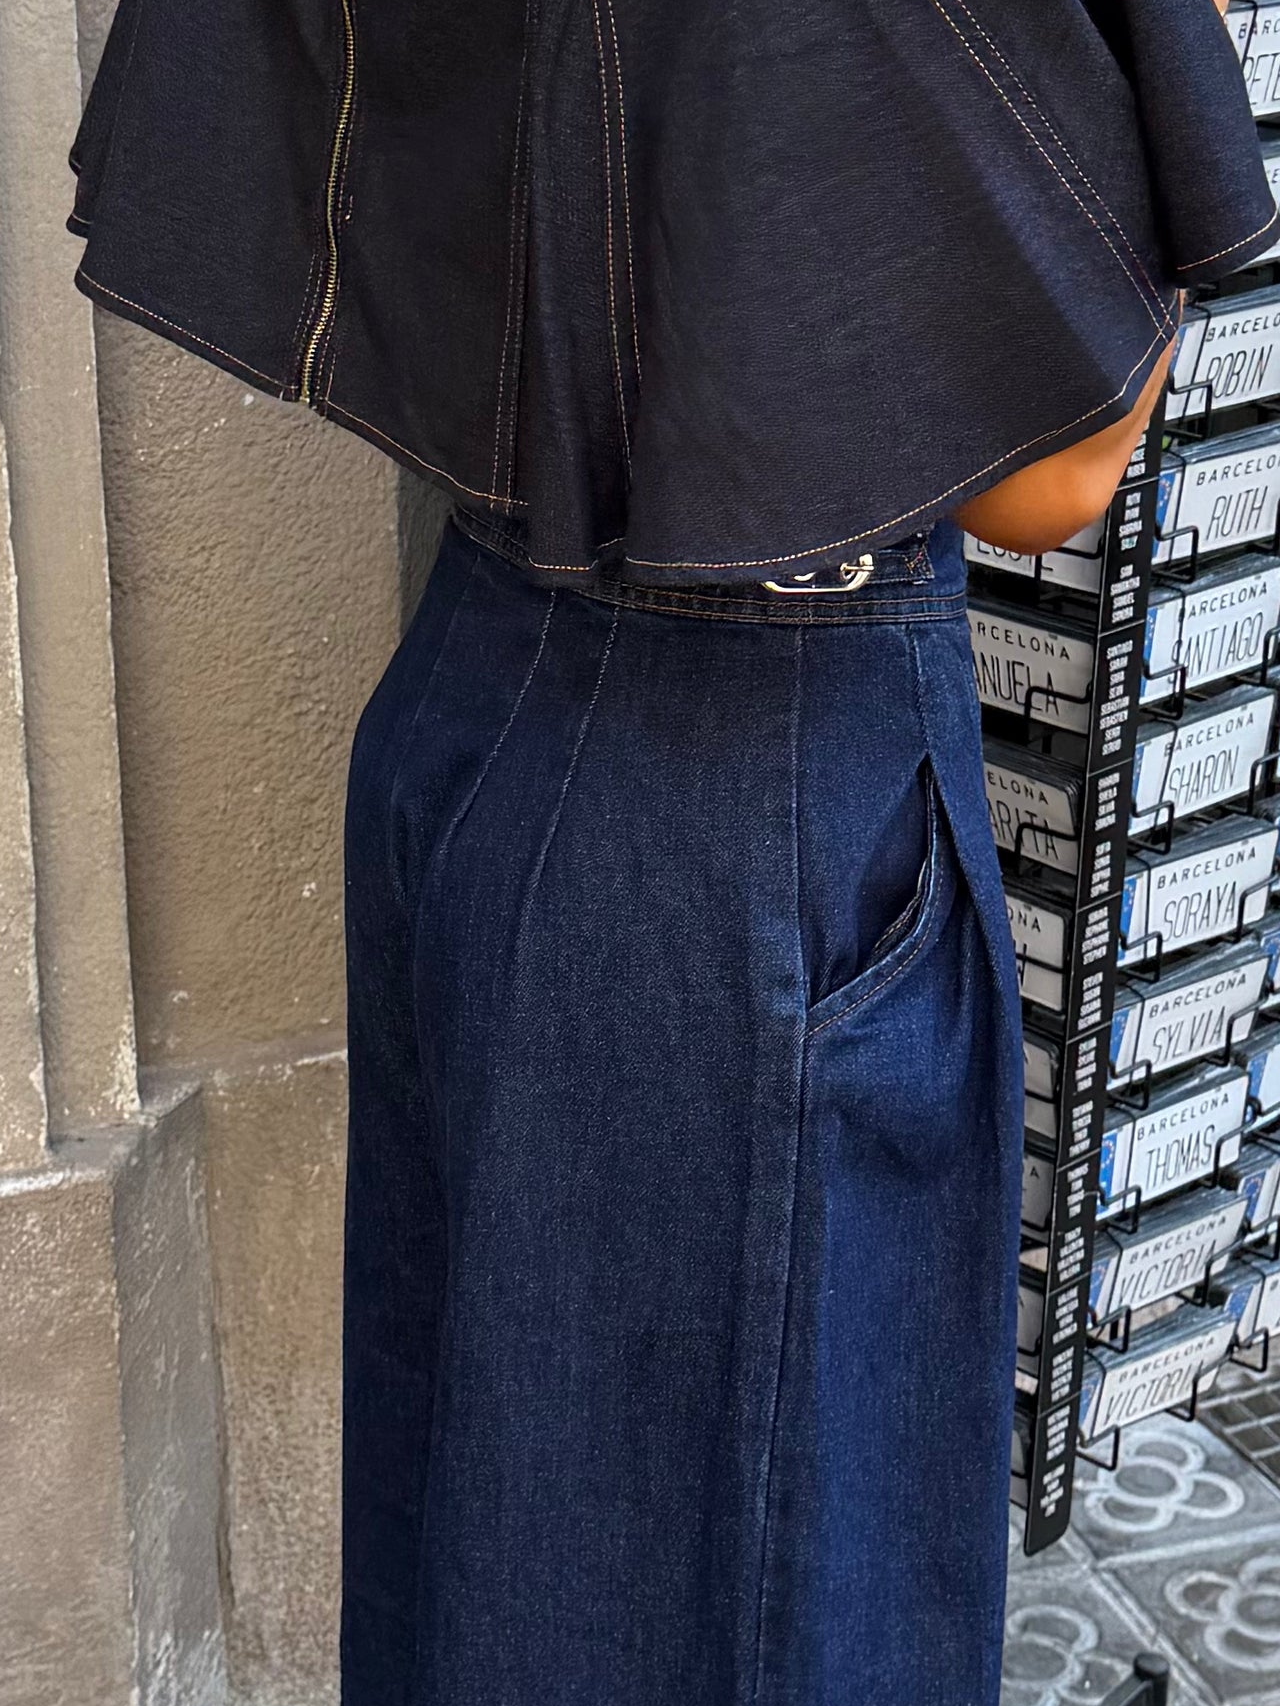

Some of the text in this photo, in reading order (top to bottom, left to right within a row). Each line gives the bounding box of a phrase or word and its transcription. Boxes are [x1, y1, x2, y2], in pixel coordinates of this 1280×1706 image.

[1198, 343, 1274, 405] ROBIN
[1205, 486, 1269, 543] RUTH
[972, 651, 1060, 718] ANUELA
[1163, 711, 1255, 757] BARCELONA
[1169, 745, 1240, 808] SHARON
[1156, 846, 1257, 890] BARCELONA
[1162, 881, 1239, 944] SORAYA
[1148, 973, 1247, 1019] BARCELONA
[1150, 1006, 1228, 1068] SYLVIA
[1136, 1092, 1231, 1141] BARCELONA
[1144, 1125, 1216, 1193] THOMAS
[1128, 1215, 1228, 1266] BARCELONA
[1120, 1239, 1219, 1302] VICTORIA
[1117, 1336, 1216, 1384] BARCELONA
